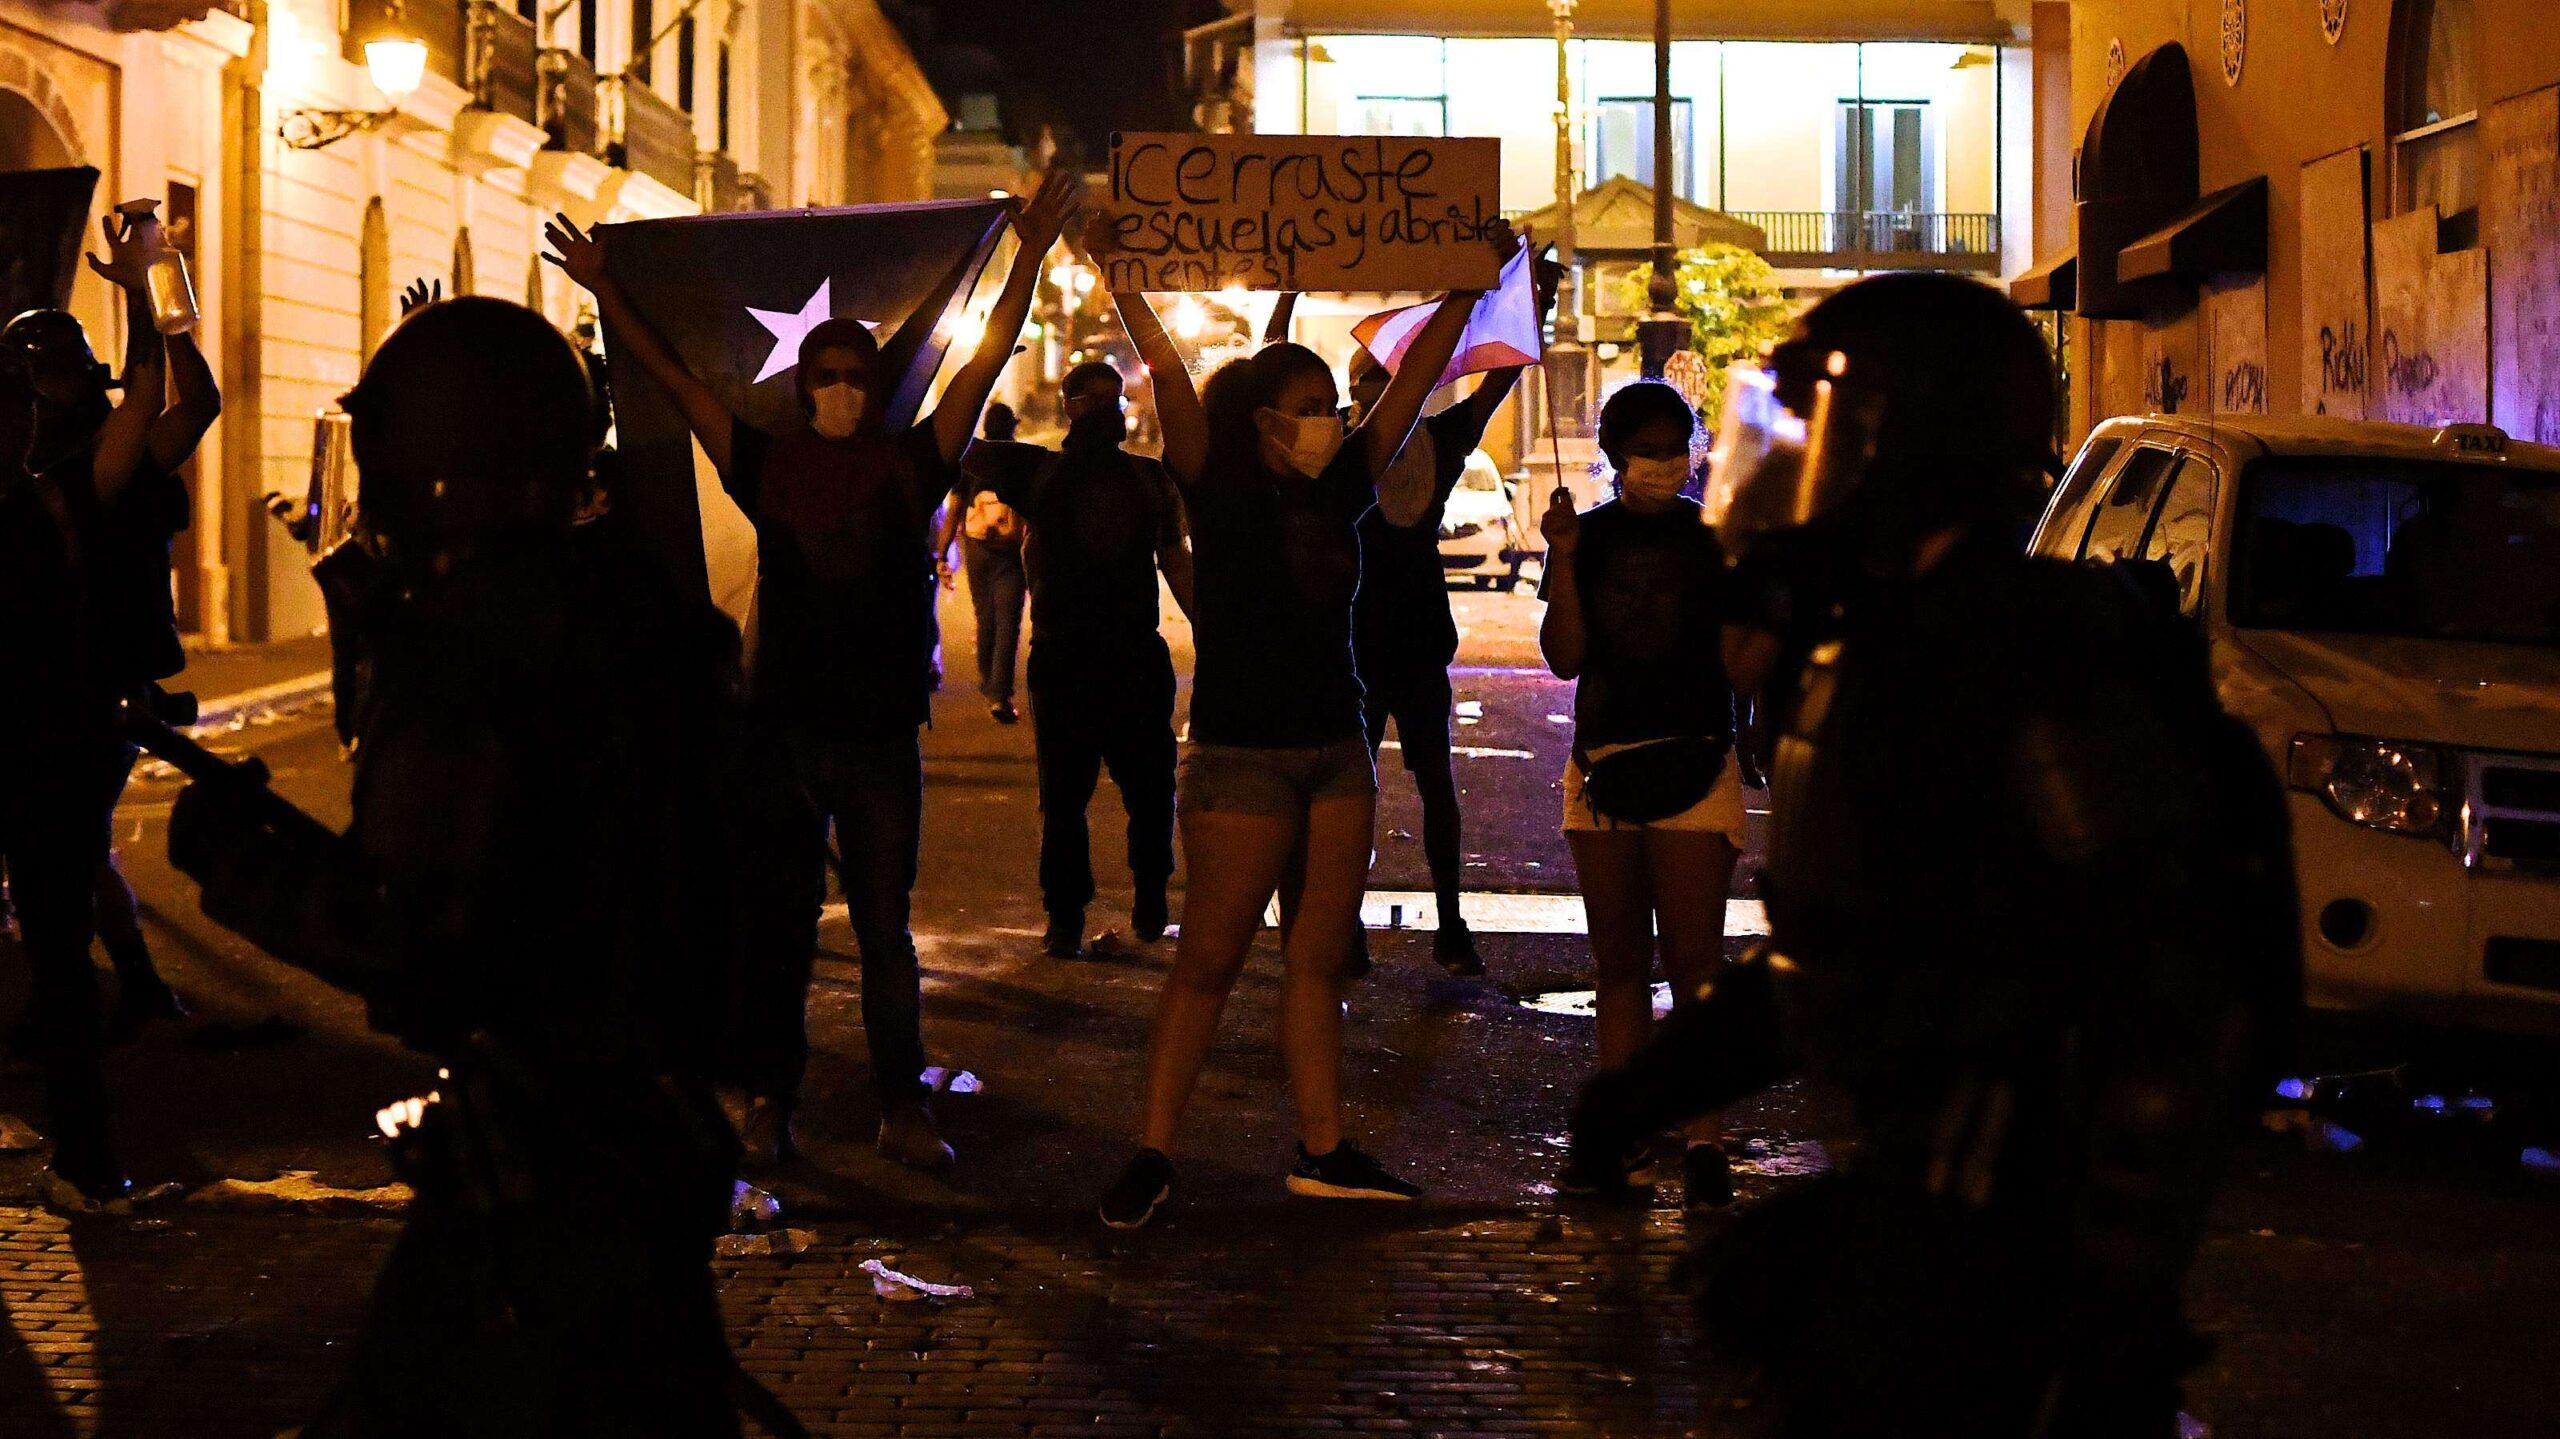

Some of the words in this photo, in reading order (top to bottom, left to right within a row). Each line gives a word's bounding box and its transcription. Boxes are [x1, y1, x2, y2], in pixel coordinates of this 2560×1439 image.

[1113, 208, 1337, 255] escuelas
[1341, 209, 1367, 270] y
[1379, 194, 1500, 246] abriste
